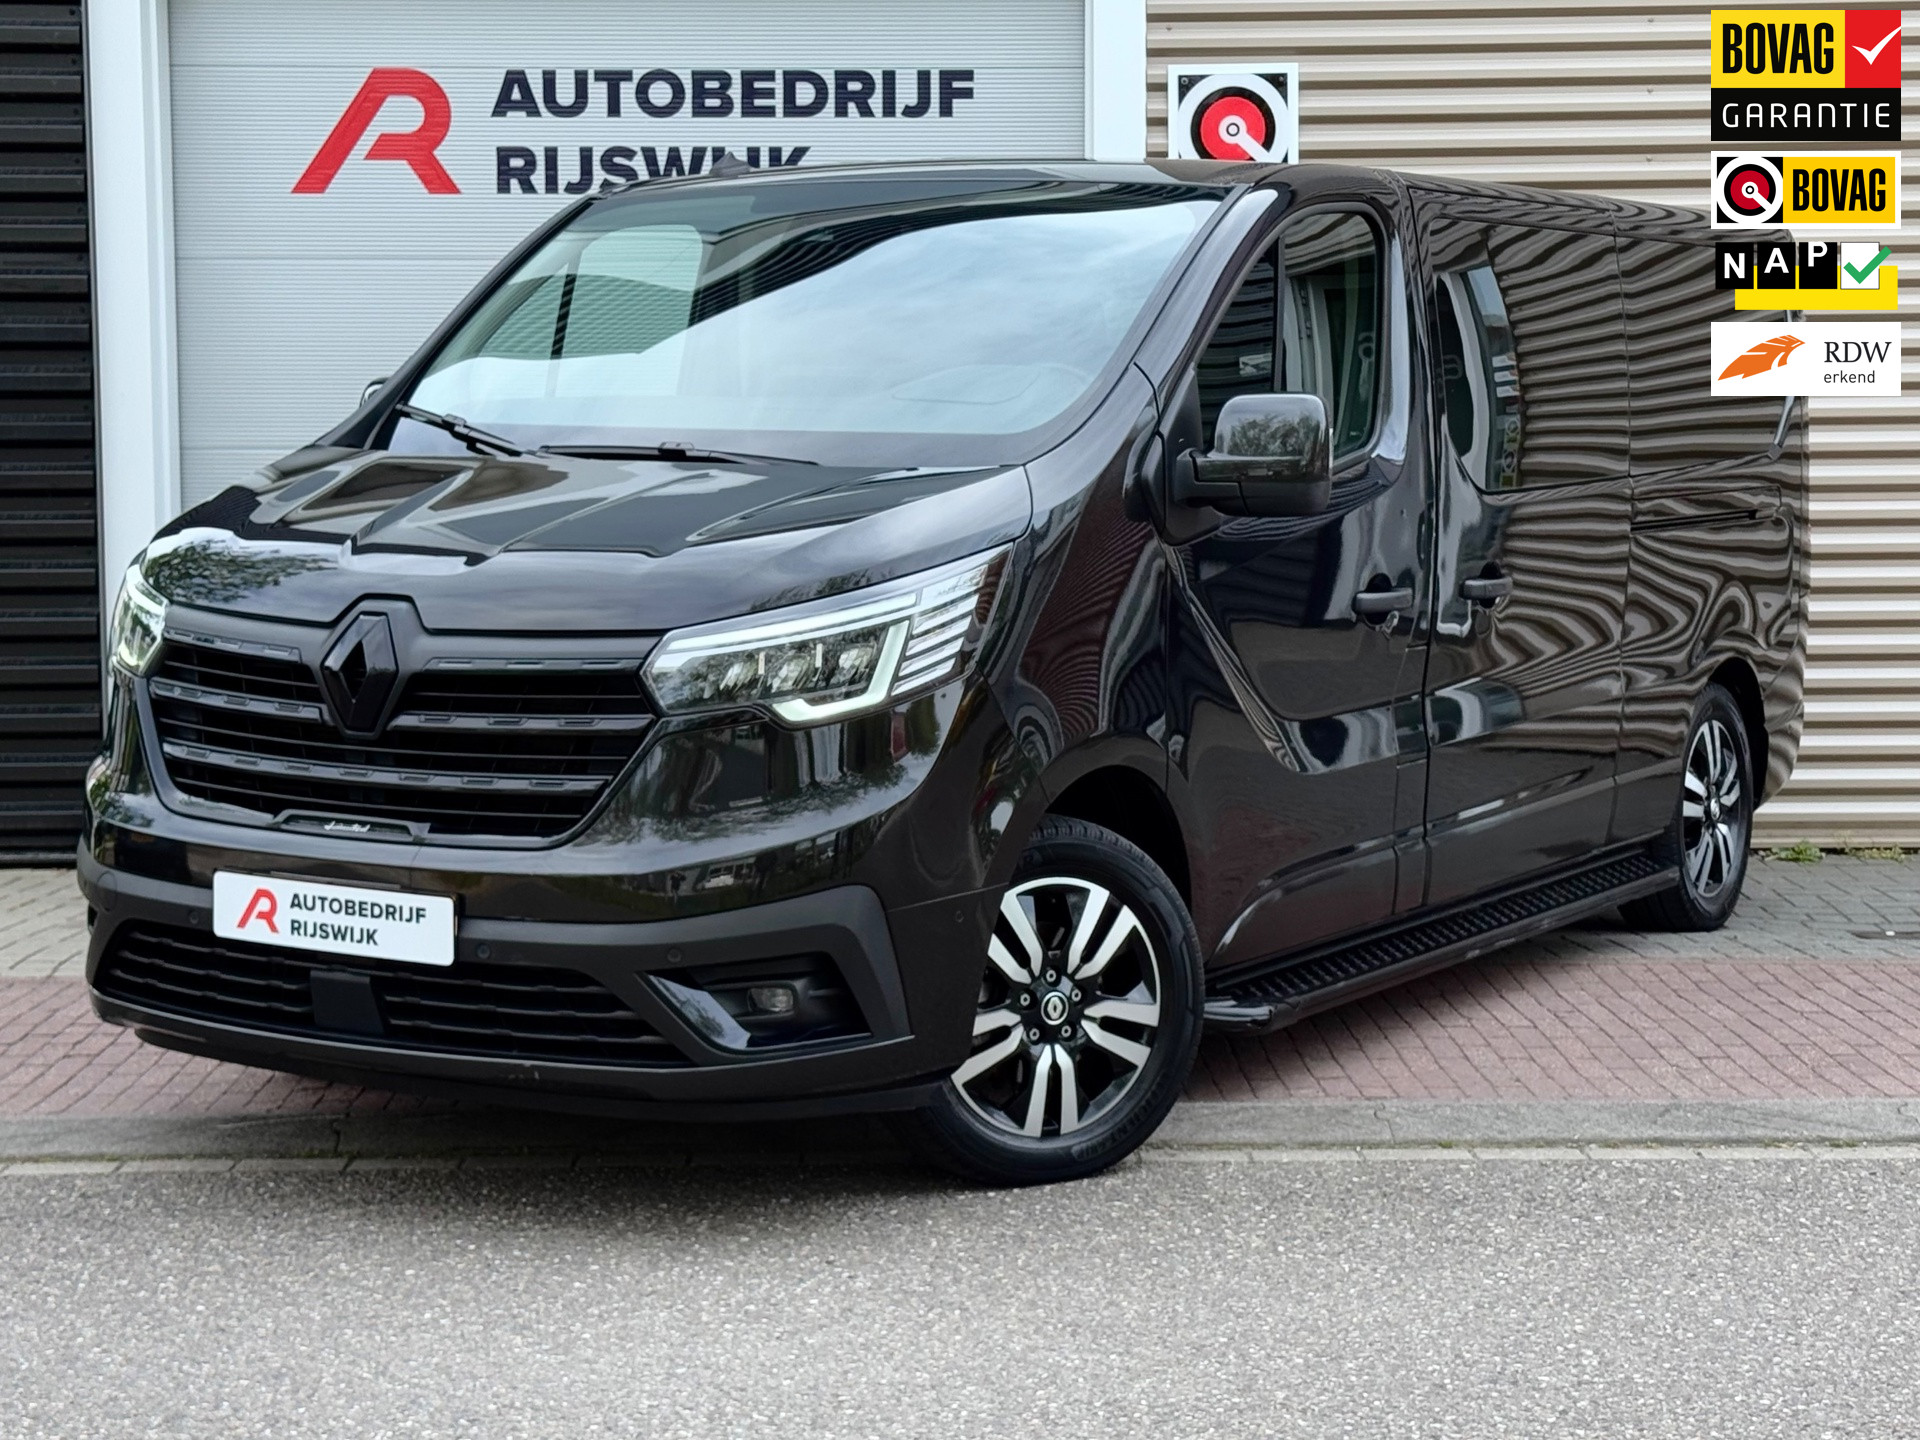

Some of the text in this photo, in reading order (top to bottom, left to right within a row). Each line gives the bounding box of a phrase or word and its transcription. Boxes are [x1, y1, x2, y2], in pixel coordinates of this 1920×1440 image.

[490, 68, 976, 118] AUTOBEDRIJF
[290, 893, 427, 924] AUTOBEDRIJF
[290, 919, 379, 946] RIJSWIJK
